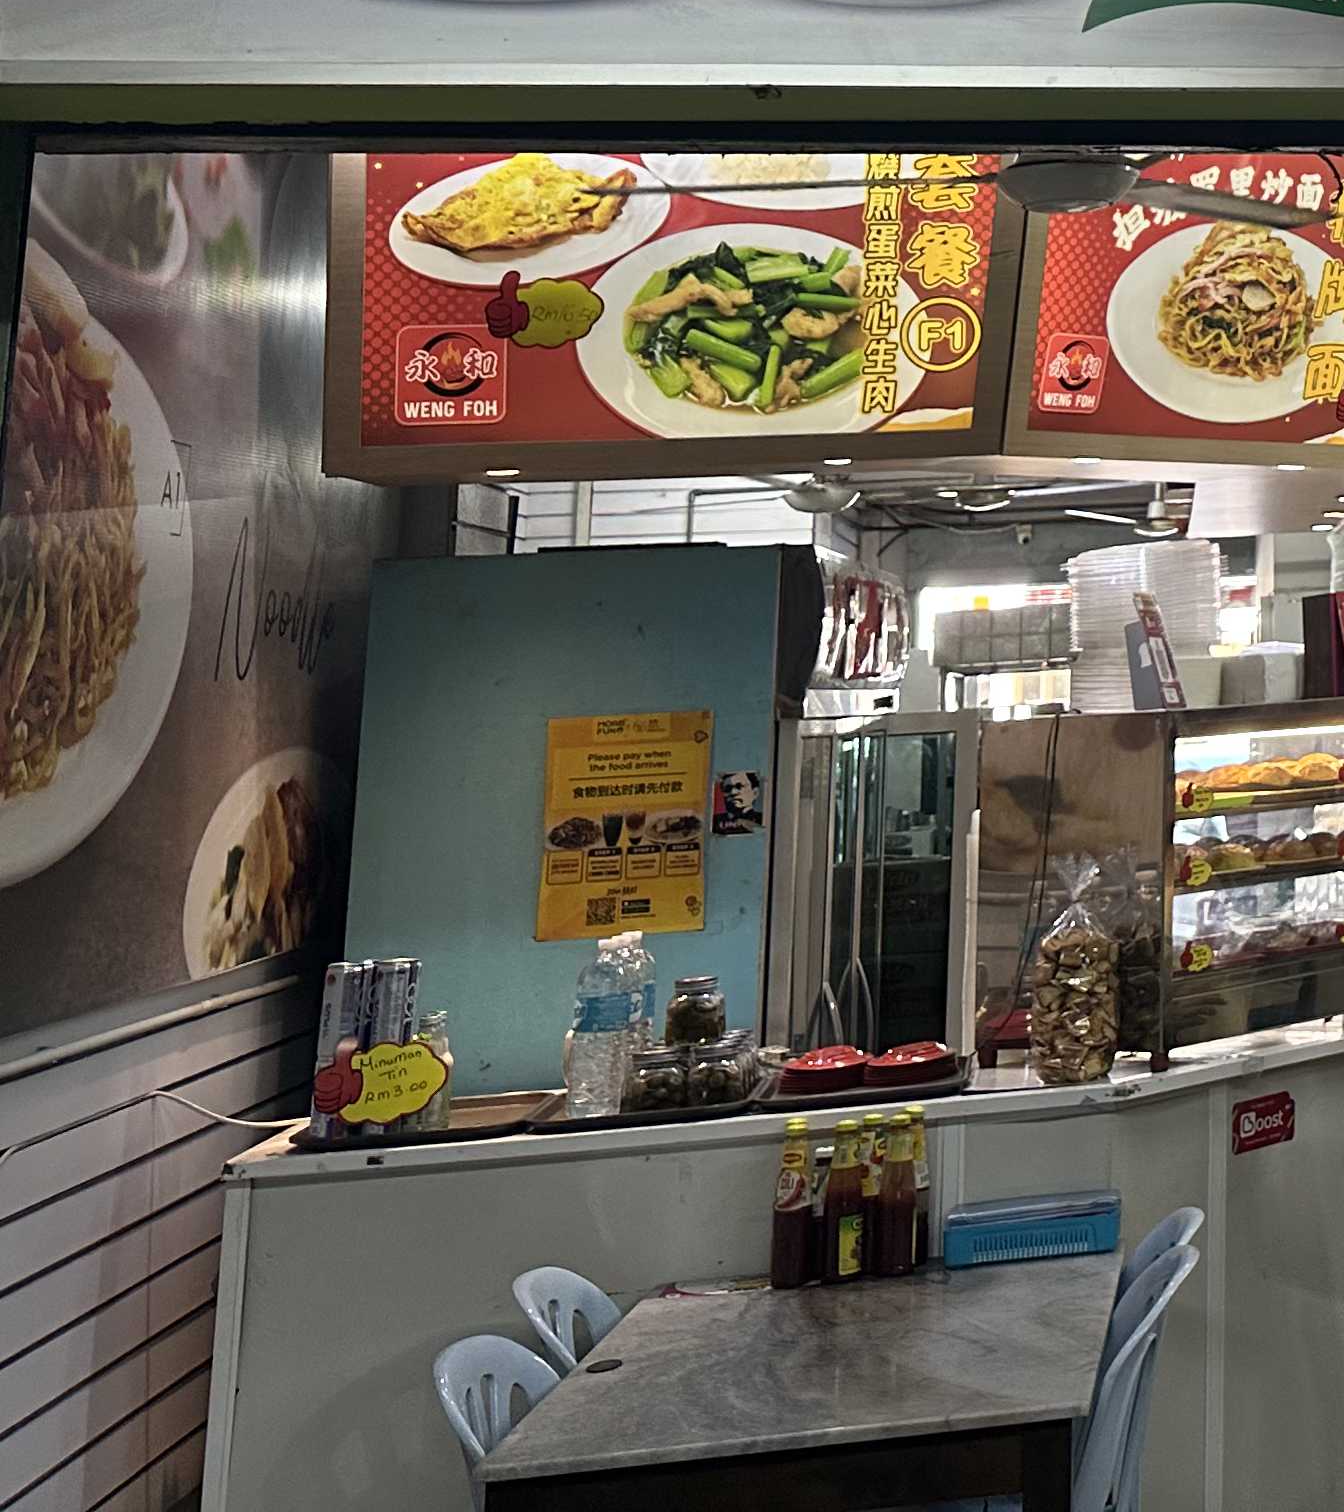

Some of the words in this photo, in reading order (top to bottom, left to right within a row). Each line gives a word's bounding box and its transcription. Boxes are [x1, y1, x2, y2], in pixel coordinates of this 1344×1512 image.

[916, 318, 967, 354] F1
[404, 346, 499, 383] 永和
[404, 399, 456, 419] WENG
[462, 398, 498, 417] FOH
[1043, 392, 1073, 407] WENG
[1075, 393, 1096, 408] FOH
[587, 753, 621, 763] Please
[623, 752, 641, 762] pay
[644, 750, 672, 759] when
[589, 763, 607, 773] the
[608, 761, 633, 772] food
[635, 760, 669, 770] arrives
